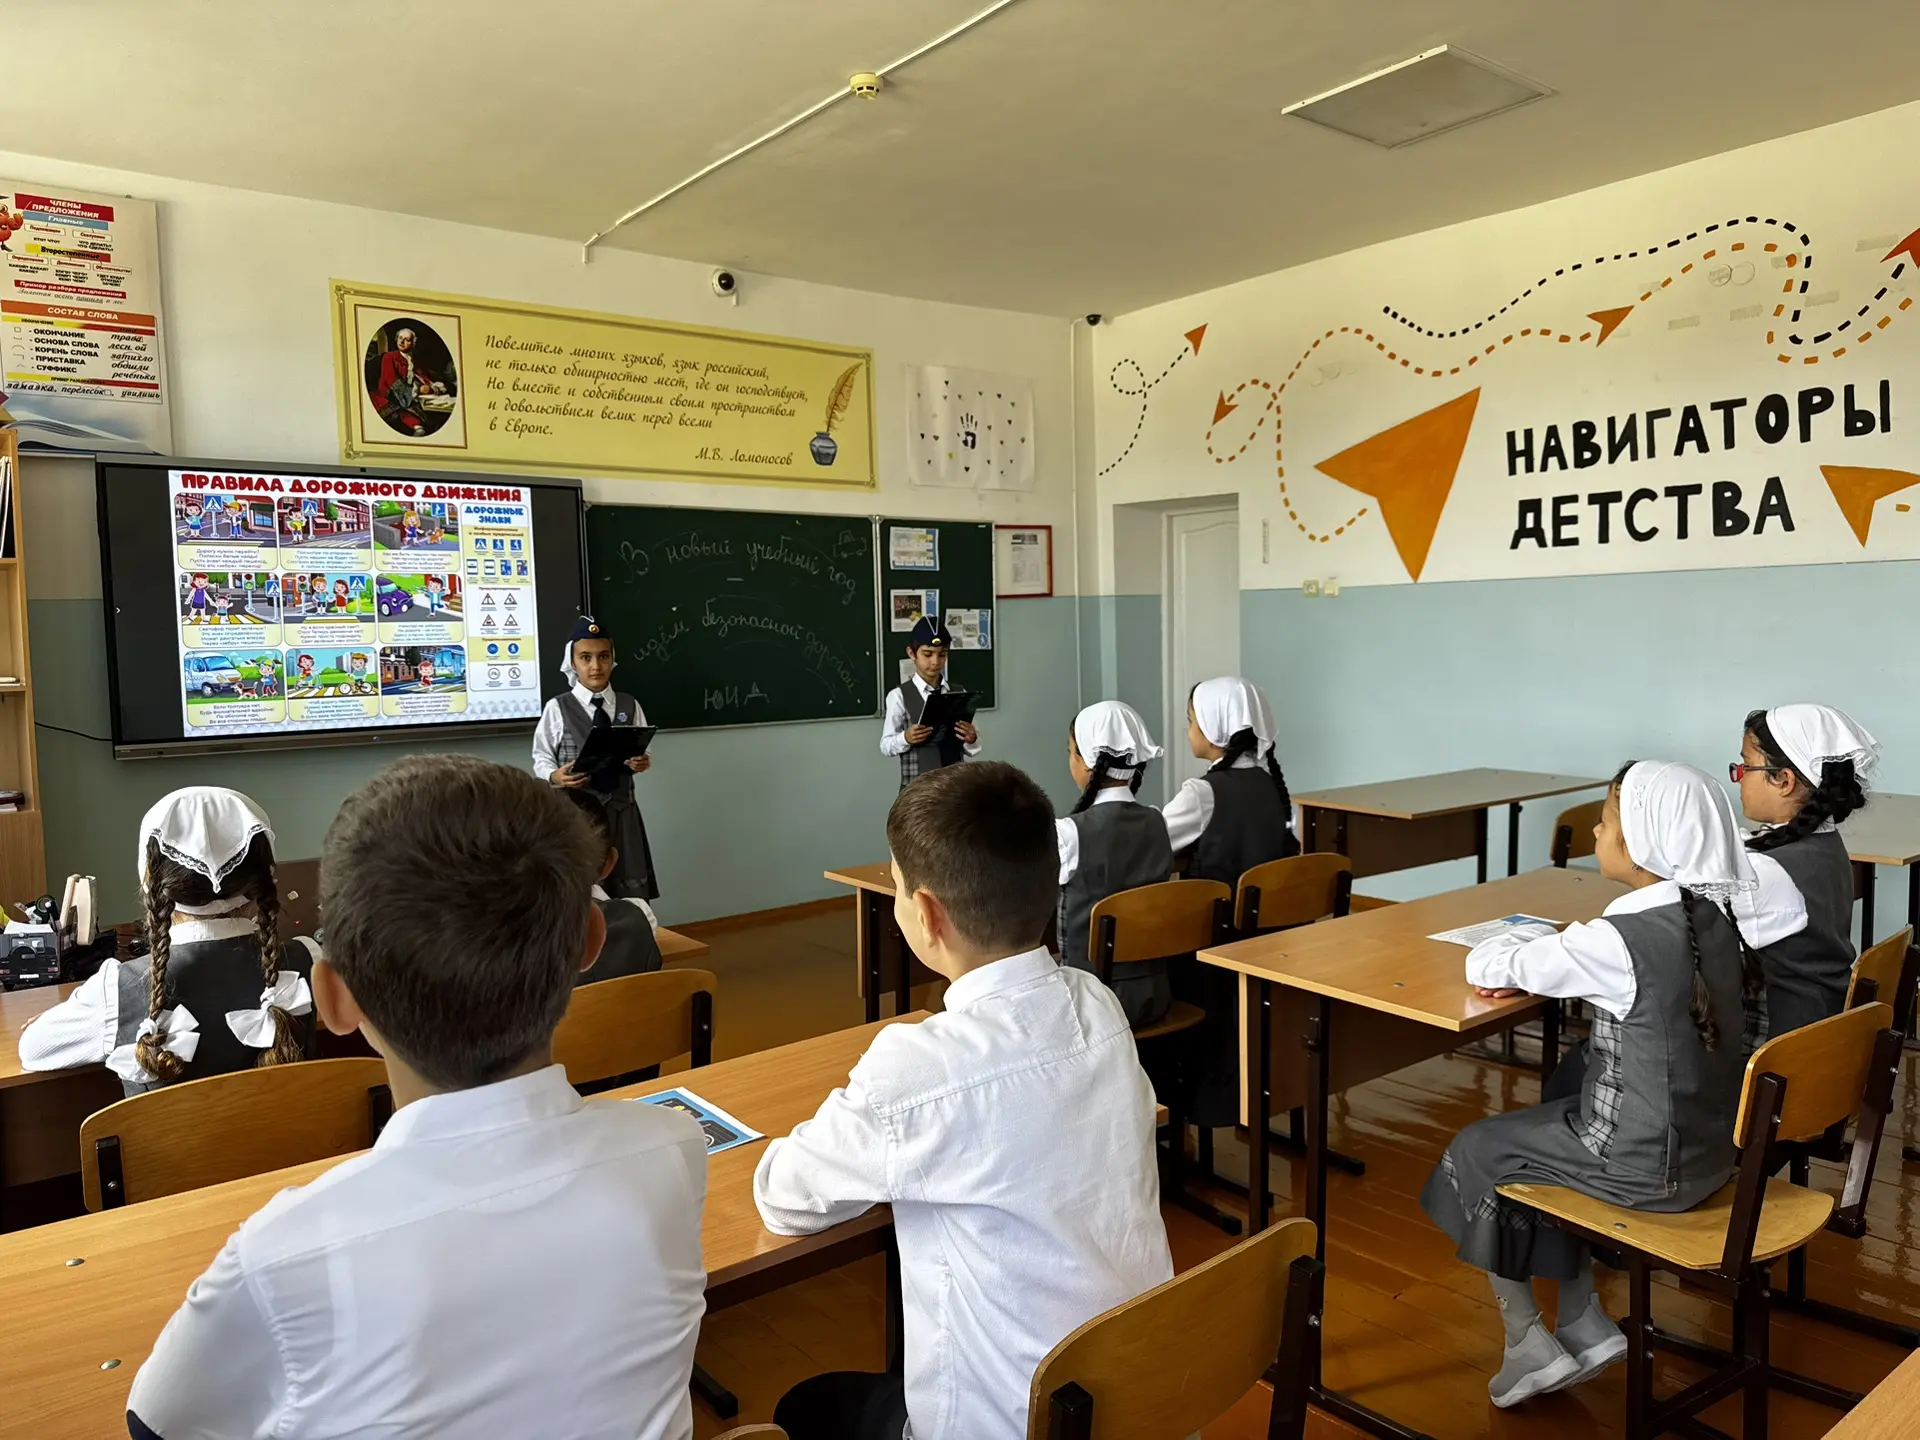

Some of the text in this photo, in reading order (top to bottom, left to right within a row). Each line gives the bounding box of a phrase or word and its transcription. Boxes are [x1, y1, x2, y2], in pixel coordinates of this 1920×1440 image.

[32, 204, 100, 219] ПРЕДЛОЖЕНИЯ
[50, 200, 82, 210] ЧЛЕНЫ
[48, 215, 84, 225] Главные
[41, 246, 100, 259] Второстепенные
[20, 281, 122, 297] Пример разбора предложения
[47, 307, 118, 321] СОСТАВ СЛОВА
[34, 329, 85, 339] ОКОНЧАНИЕ
[34, 338, 100, 349] ОСНОВА СЛОВА
[35, 346, 99, 358] КОРЕНЬ СЛОВА
[486, 335, 769, 380] Повелитель многих языков, язык российский,
[36, 355, 86, 365] ПРИСТАВКА
[36, 364, 77, 373] СУФФИКС
[112, 372, 155, 381] реченька
[486, 359, 808, 404] не только обширностью мест, где он господствует,
[487, 377, 796, 418] Но вместе и собственным своим пространством
[488, 398, 713, 429] и довольствием велик перед всеми
[489, 417, 553, 438] в Европе.
[1506, 379, 1891, 476] НАВИГАТОРЫ
[695, 447, 793, 465] М.В. Ломоносов
[181, 474, 521, 502] ПРАВИЛА ДОРОЖНОГО ДВИЖЕНИЯ
[465, 506, 524, 516] ДОРОЖНЫЕ
[1510, 476, 1795, 550] ДЕТСТВА
[479, 516, 512, 524] ЗНАКИ
[616, 532, 856, 605] В новый учебный год
[634, 620, 690, 661] идём
[702, 598, 804, 638] безопасной
